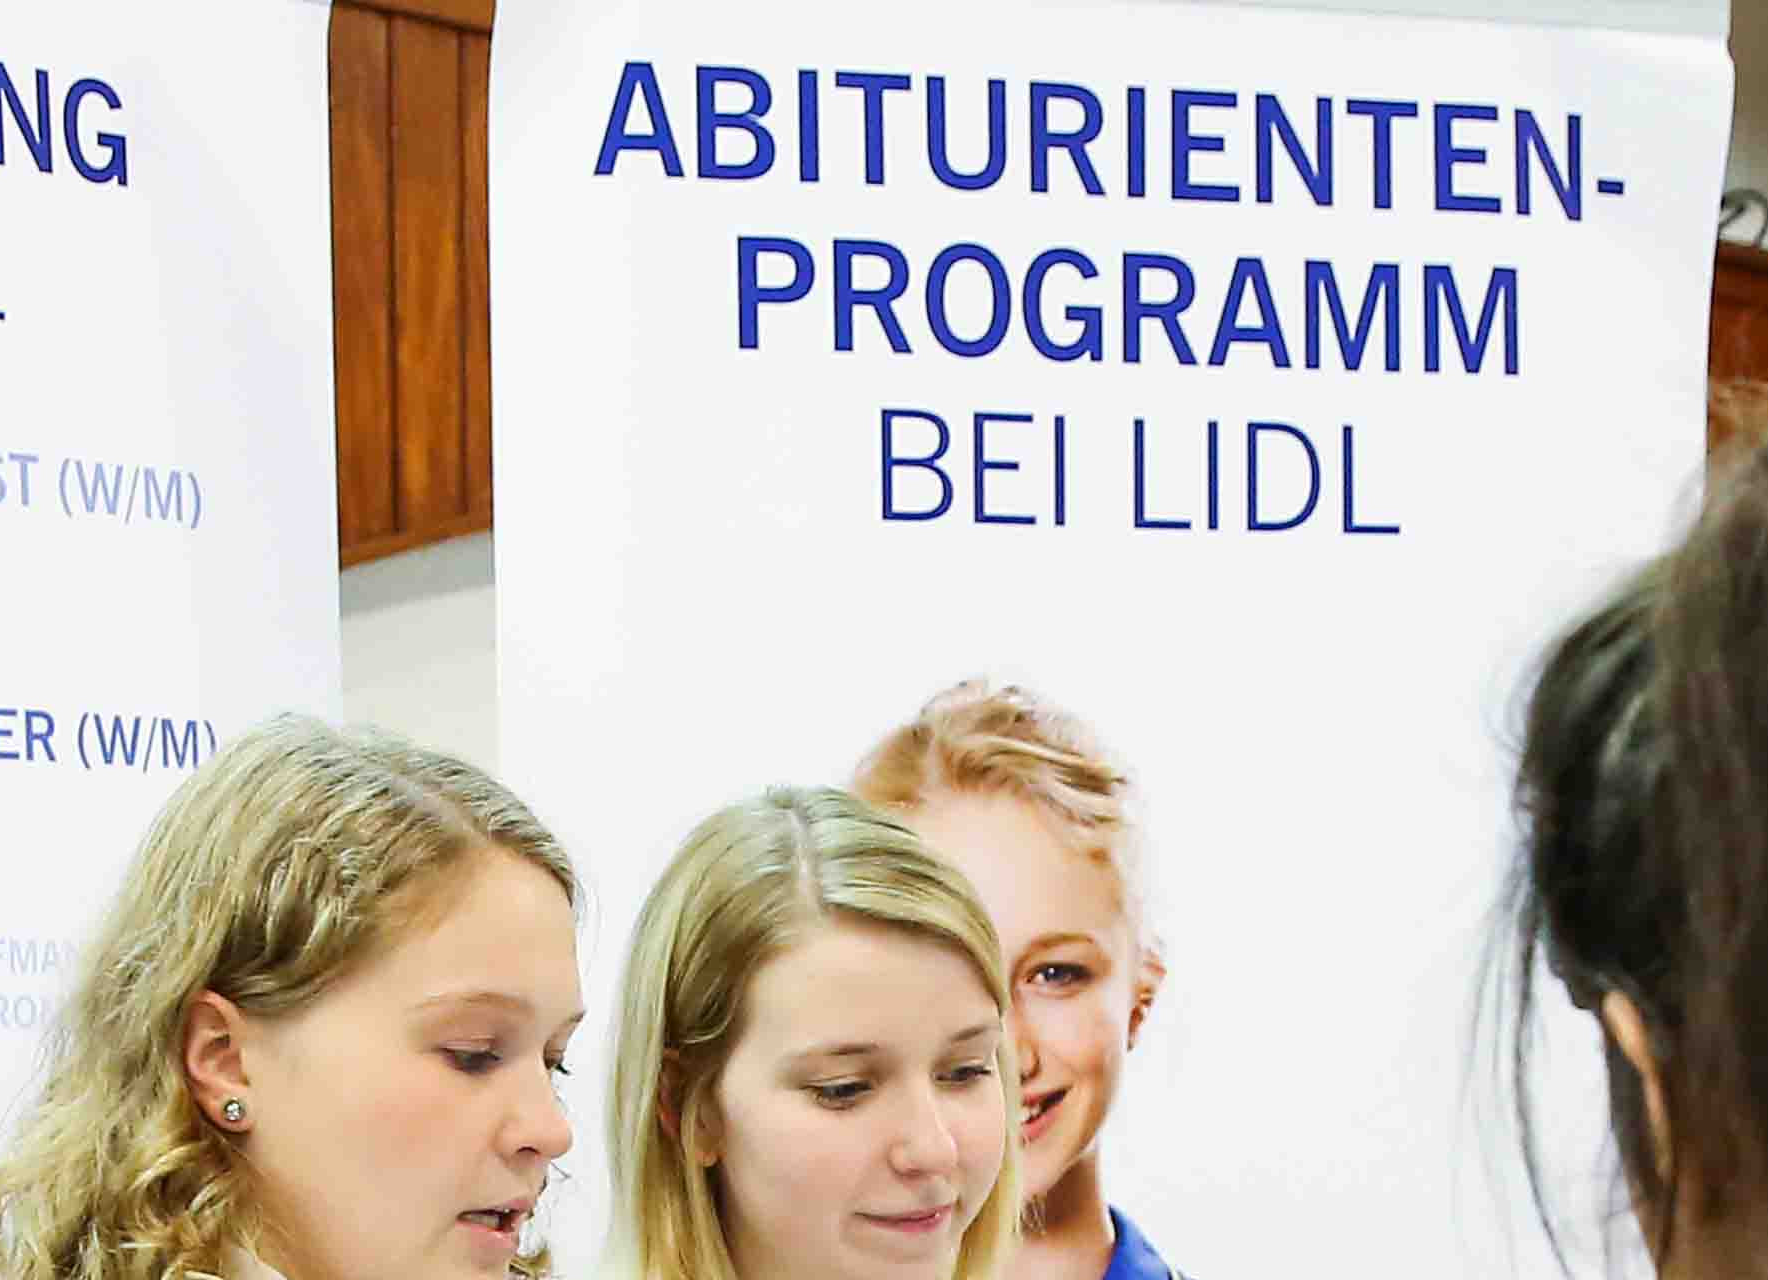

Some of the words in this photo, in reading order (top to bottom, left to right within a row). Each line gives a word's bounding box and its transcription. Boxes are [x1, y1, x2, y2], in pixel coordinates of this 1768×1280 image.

[594, 60, 1626, 222] ABITURIENTEN-
[735, 235, 1521, 377] PROGRAMM
[58, 456, 204, 530] (W/M)
[879, 407, 1068, 528] BEI
[1132, 416, 1401, 535] LIDL
[77, 711, 217, 773] (W/M)
